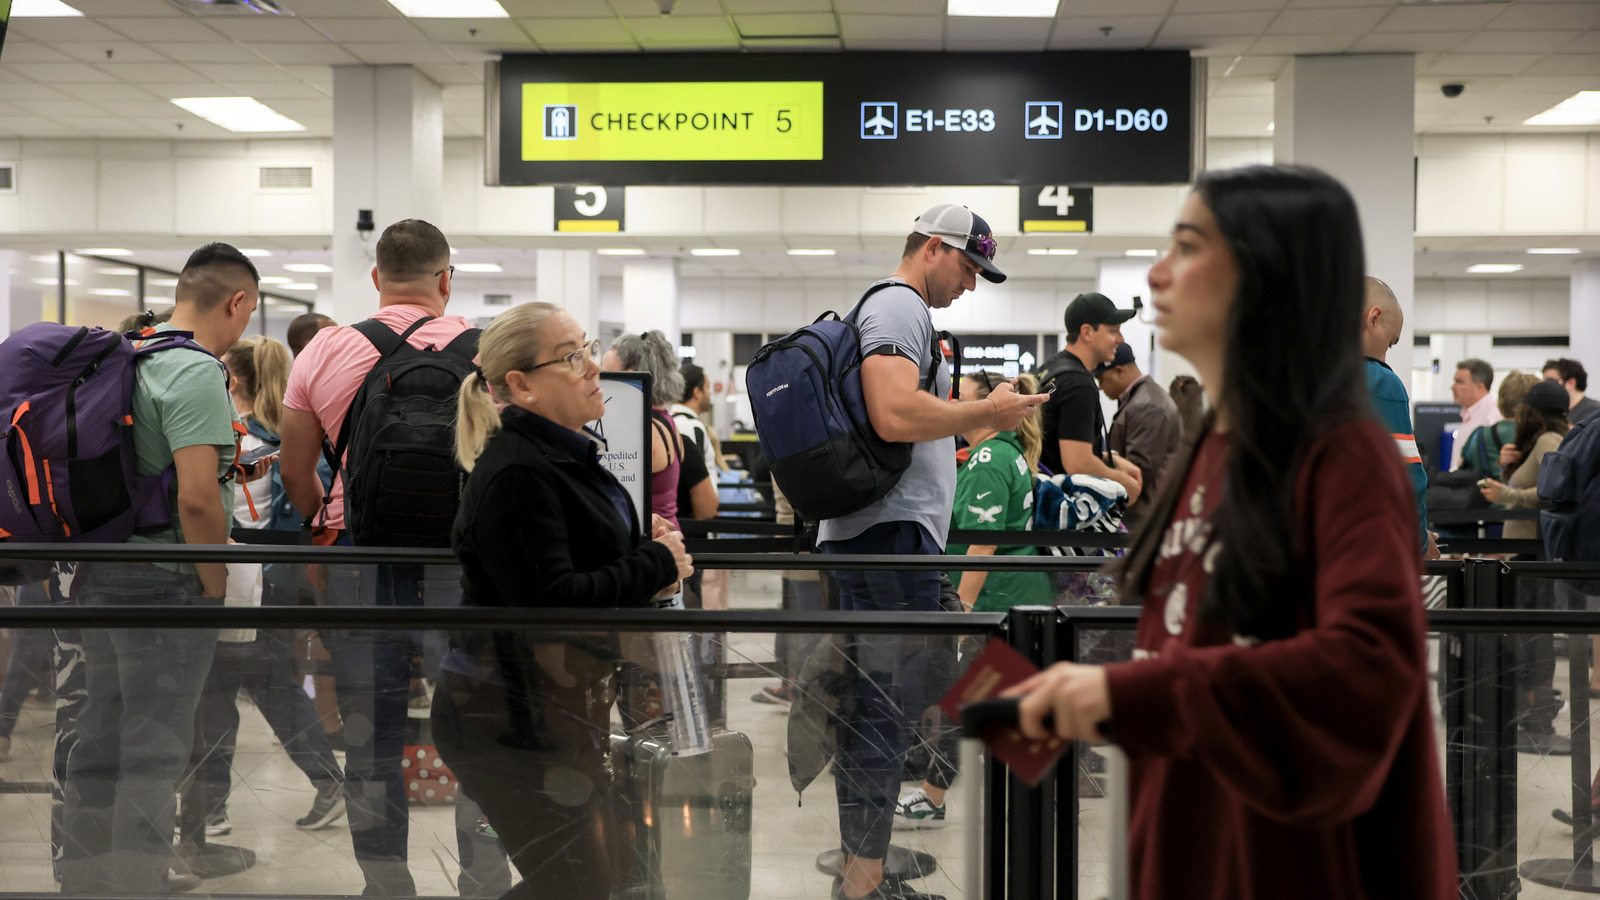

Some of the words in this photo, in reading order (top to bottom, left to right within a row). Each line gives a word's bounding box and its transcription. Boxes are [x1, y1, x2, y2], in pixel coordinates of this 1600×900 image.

[590, 112, 754, 131] CHECKPOINT
[776, 109, 793, 133] 5
[905, 108, 996, 132] E1-E33
[1073, 108, 1168, 132] D1-D60
[574, 185, 607, 216] 5
[1038, 185, 1074, 216] 4
[602, 451, 638, 462] xpedited
[609, 462, 627, 471] U.S.
[967, 447, 992, 470] 26
[620, 473, 636, 482] and
